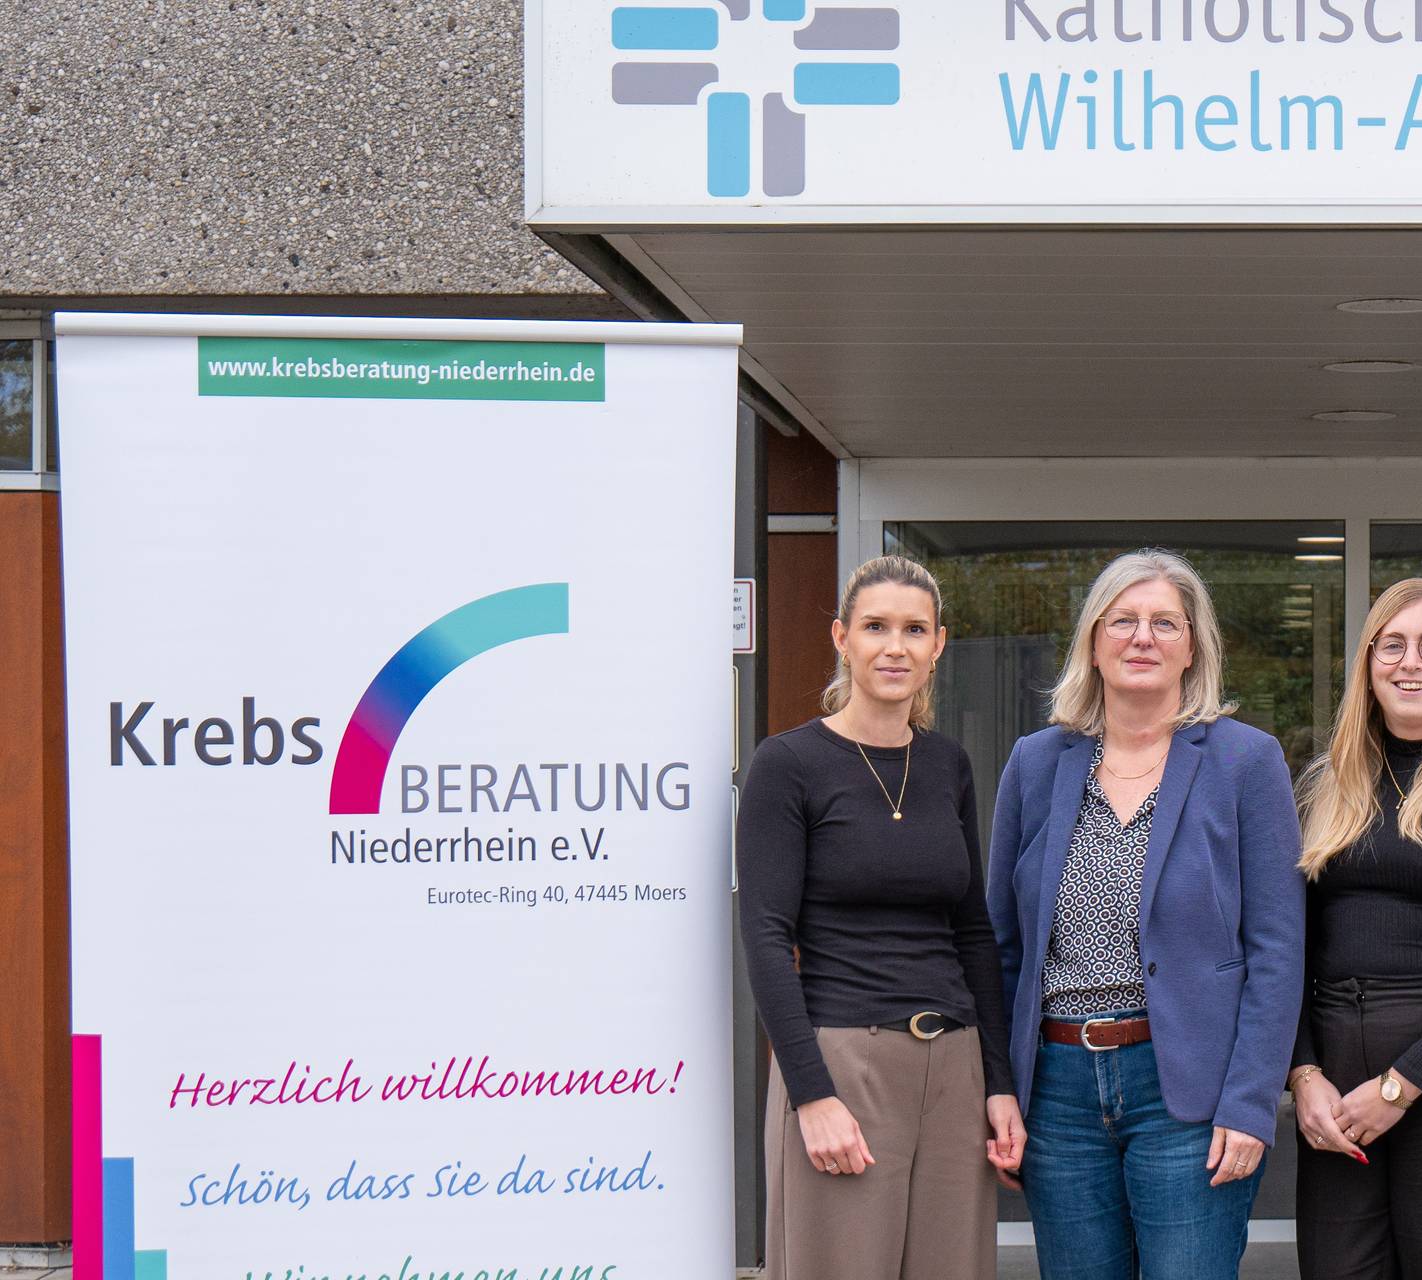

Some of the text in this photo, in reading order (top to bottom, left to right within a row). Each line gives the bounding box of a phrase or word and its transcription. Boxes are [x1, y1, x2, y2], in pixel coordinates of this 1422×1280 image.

[207, 356, 596, 384] www.krebsberatung-niederrhein.de
[109, 696, 324, 767] Krebs
[400, 761, 690, 814] BERATUNG
[331, 827, 609, 864] Niederrhein e.V.
[427, 885, 687, 907] Eurotec-Ring 40, 47445 Moers
[170, 1055, 685, 1109] Herzlich willkommen!
[180, 1150, 665, 1210] Schön, dass Sie da sind.
